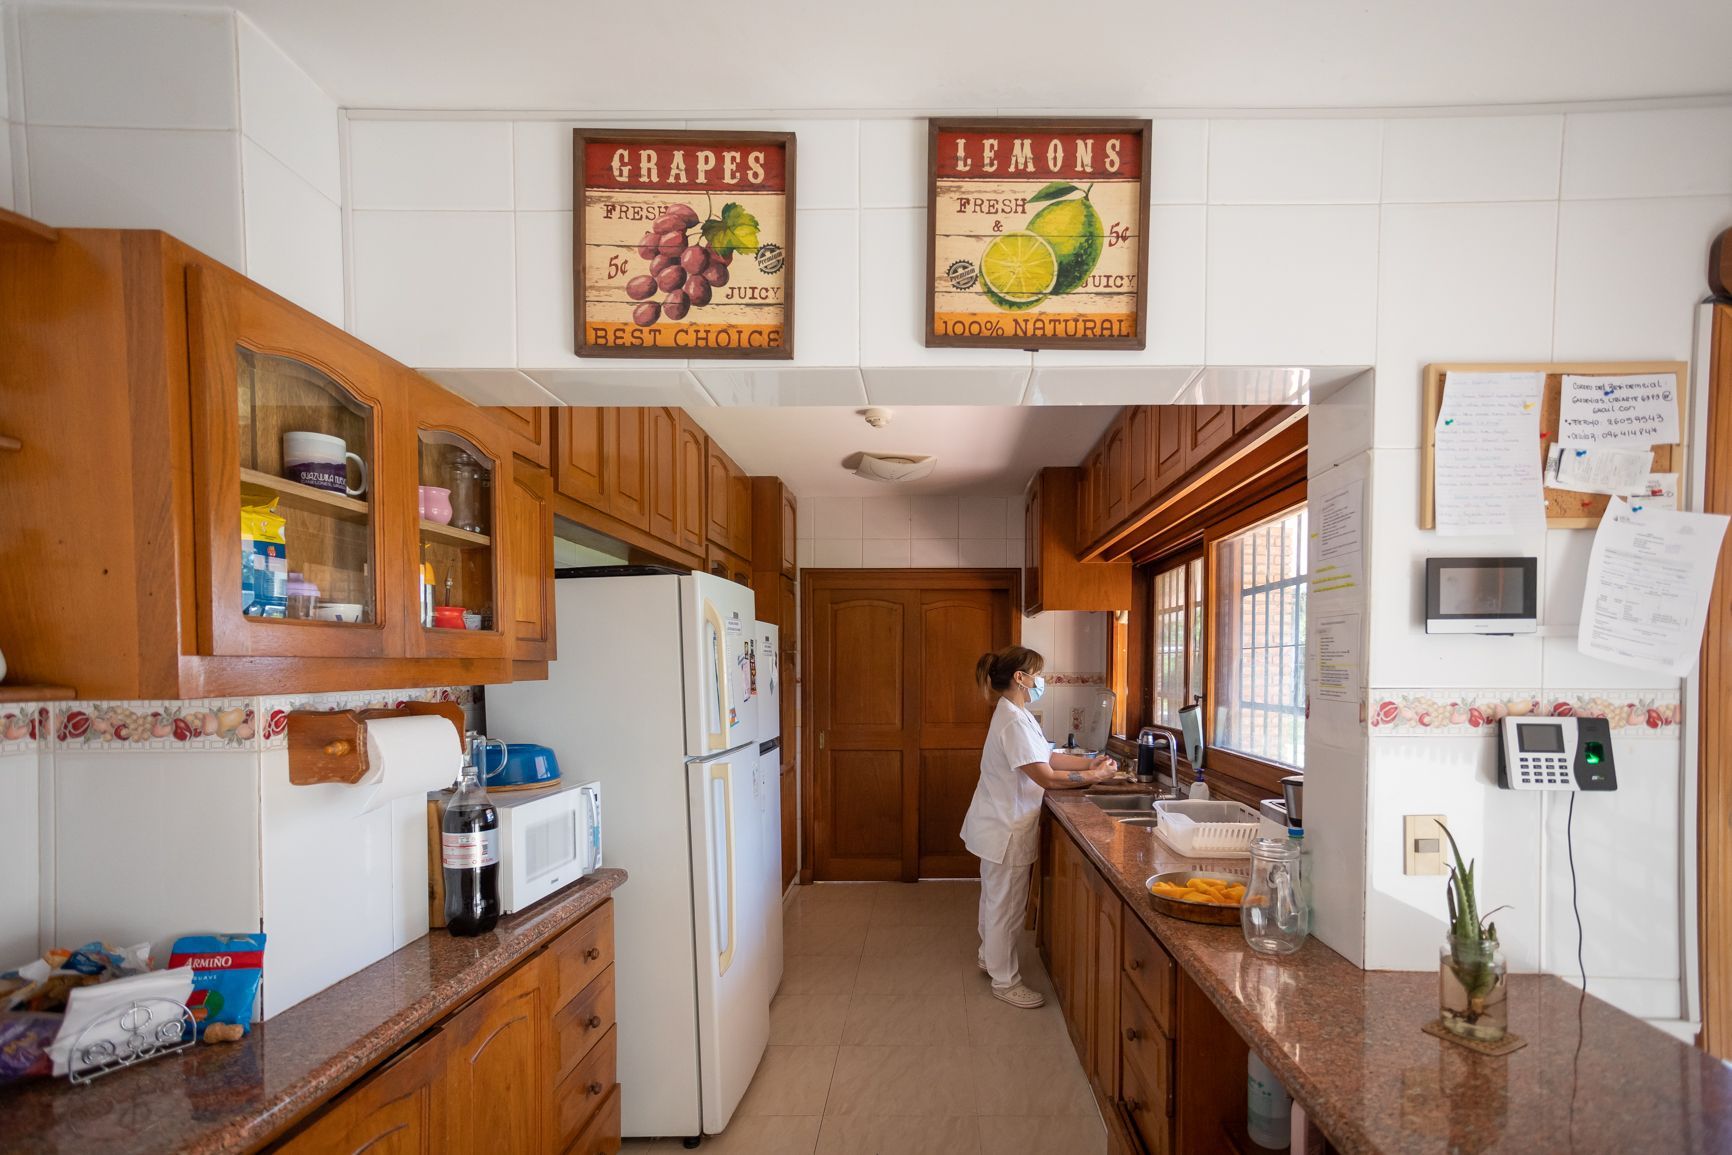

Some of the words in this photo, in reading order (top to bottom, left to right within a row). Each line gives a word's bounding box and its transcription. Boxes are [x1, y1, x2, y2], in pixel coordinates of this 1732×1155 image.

[955, 138, 1120, 172] LEMONS
[610, 148, 765, 184] GRAPES
[603, 204, 669, 221] FRESH
[956, 197, 1027, 214] FRESH
[992, 220, 1003, 232] &
[725, 286, 781, 300] JUICY
[942, 320, 1005, 337] 100%
[1013, 318, 1130, 338] NATURAL
[592, 327, 662, 347] BEST
[673, 329, 782, 348] CHOICE
[184, 956, 232, 968] ARMIÑO
